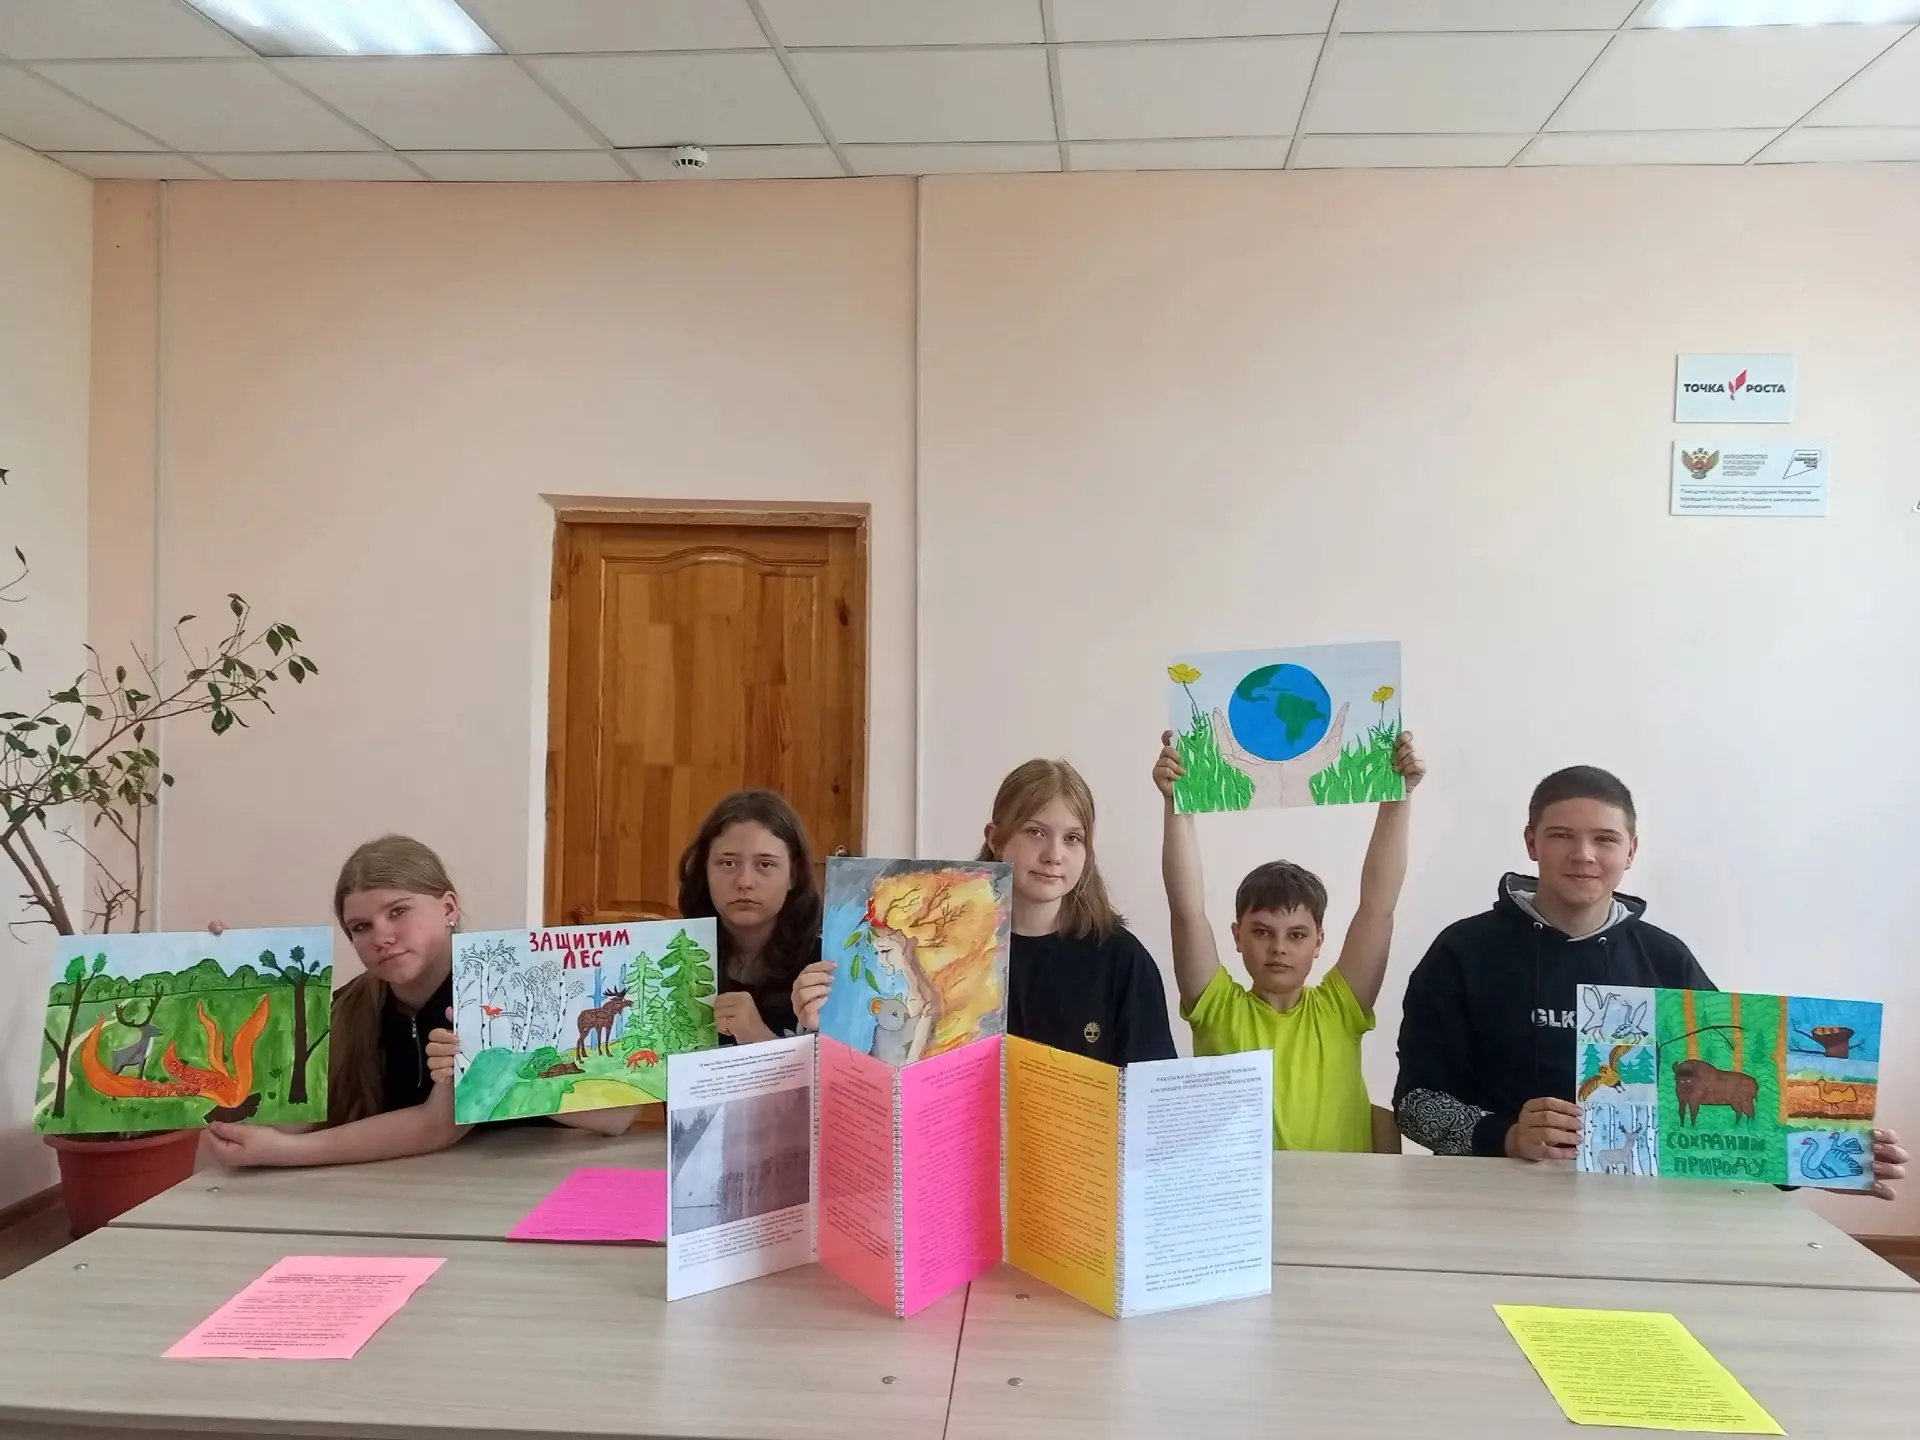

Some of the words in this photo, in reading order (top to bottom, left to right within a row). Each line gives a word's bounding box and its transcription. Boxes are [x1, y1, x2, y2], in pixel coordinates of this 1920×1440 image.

[1683, 383, 1725, 393] ТОЧКА
[1746, 384, 1786, 393] РОСТА
[529, 929, 630, 952] ЗАЩИТИМ
[563, 949, 603, 969] ЛЕС
[1666, 1132, 1766, 1152] СОХРАНИМ
[1673, 1156, 1767, 1178] ПРИРОДУ
